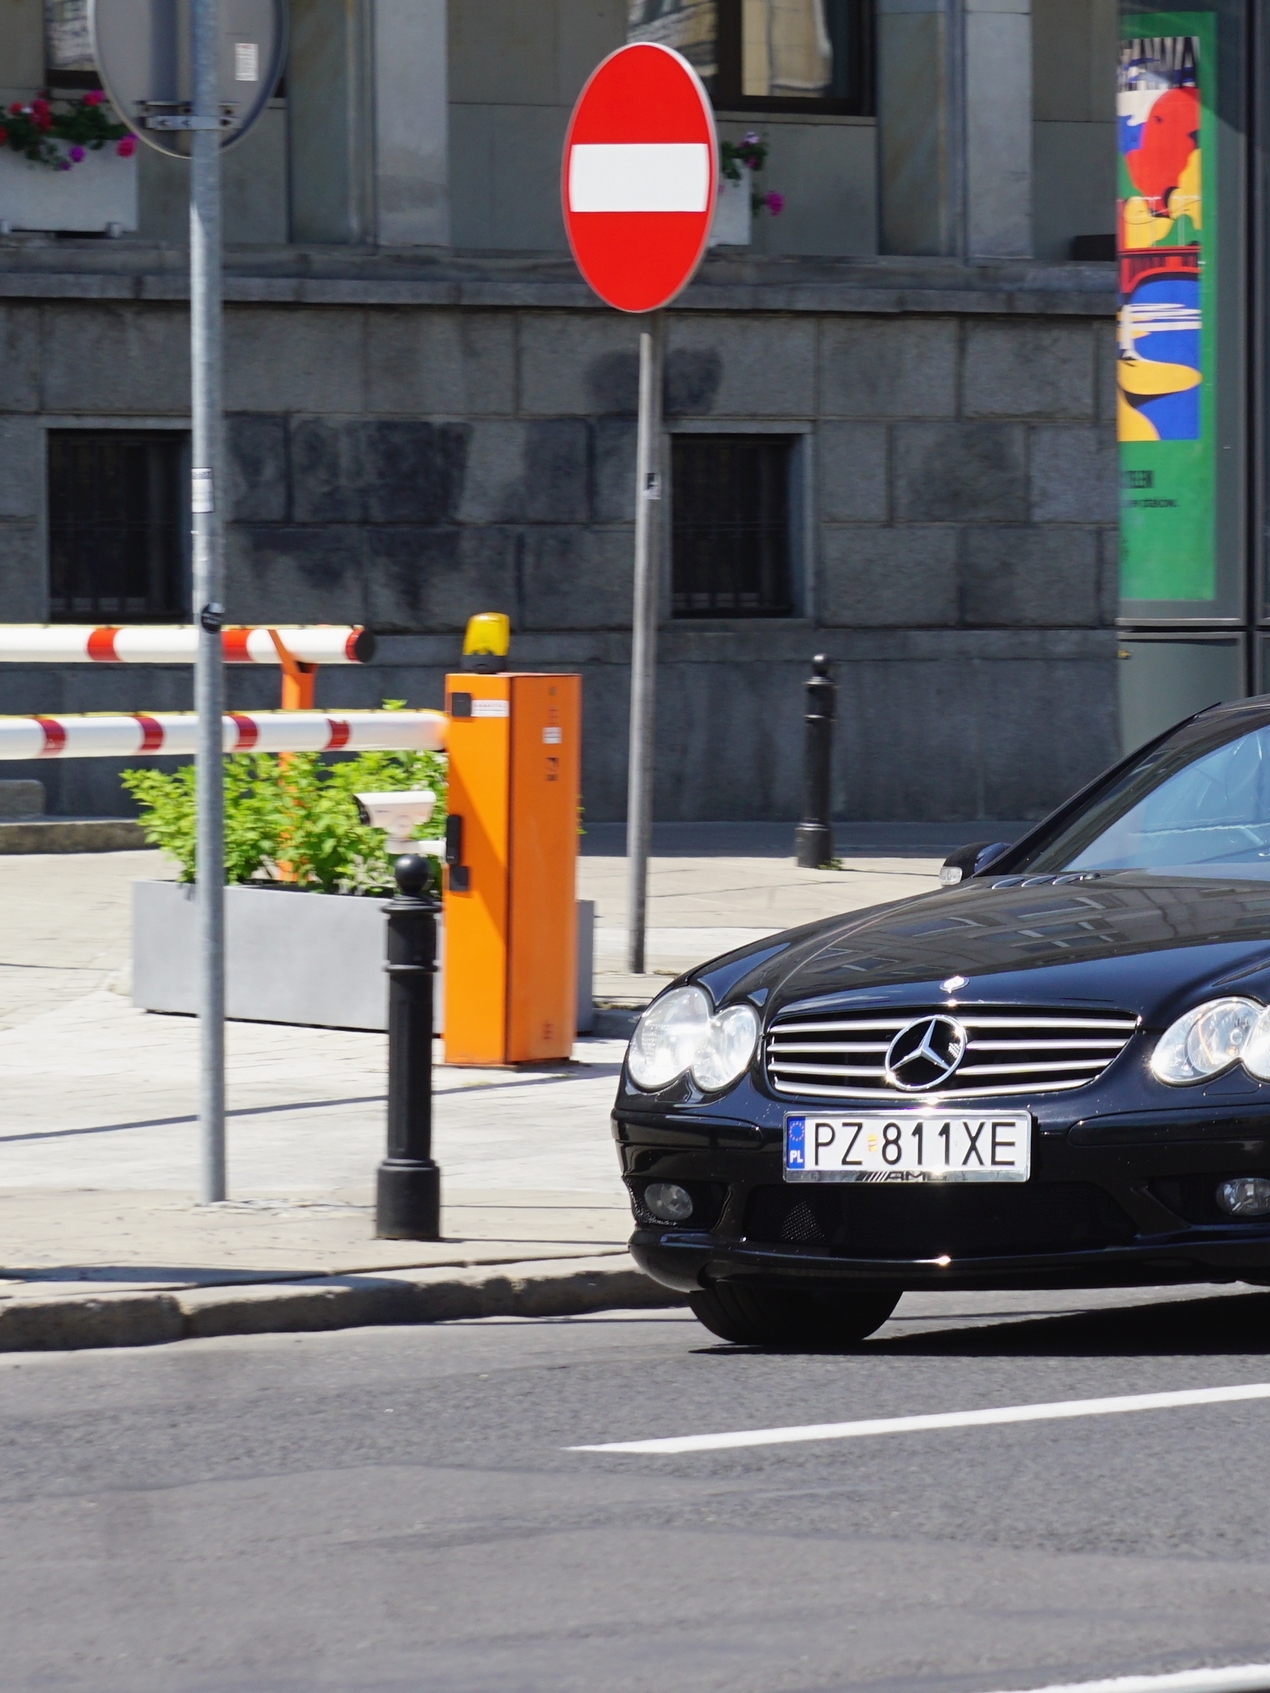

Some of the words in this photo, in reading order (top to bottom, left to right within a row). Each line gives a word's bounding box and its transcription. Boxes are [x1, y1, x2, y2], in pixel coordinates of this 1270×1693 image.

[790, 1150, 804, 1163] PL
[815, 1122, 863, 1166] PZ
[881, 1121, 1016, 1166] 811XE
